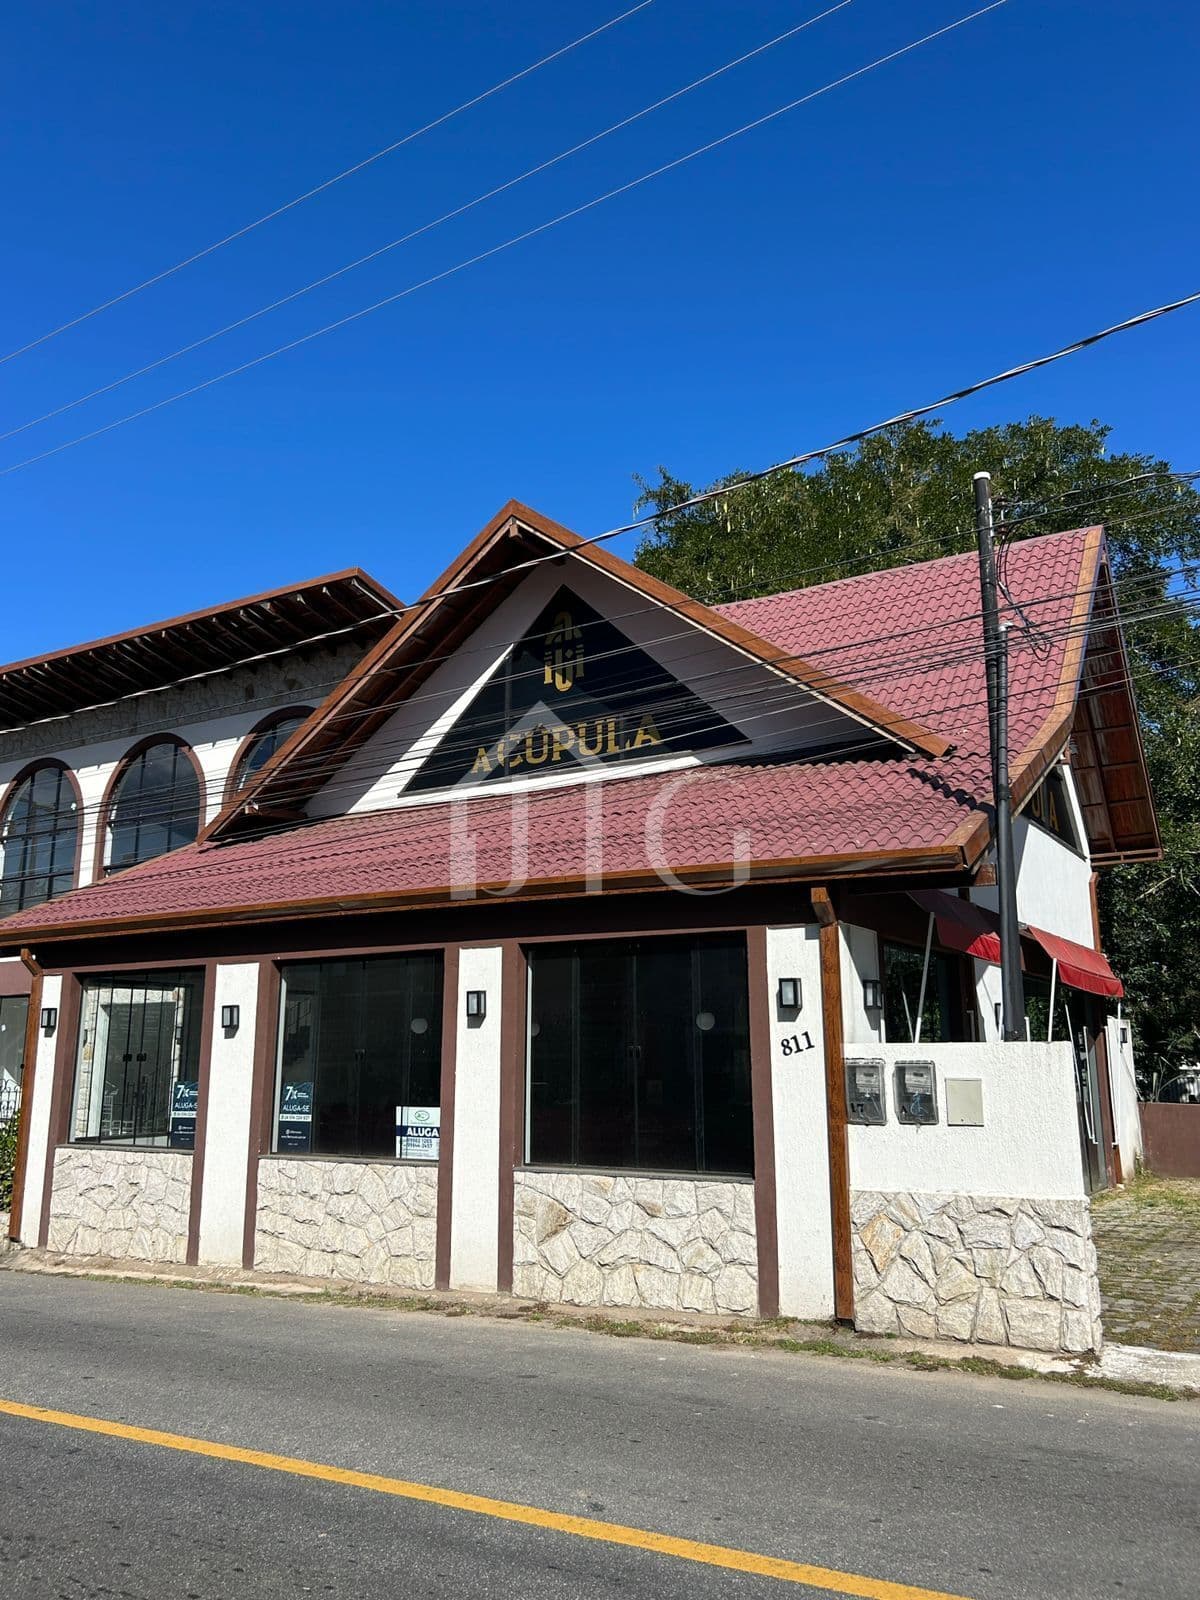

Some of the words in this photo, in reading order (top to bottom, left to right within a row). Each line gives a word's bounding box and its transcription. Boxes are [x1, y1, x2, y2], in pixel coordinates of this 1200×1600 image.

[471, 748, 493, 773] A
[780, 1031, 815, 1057] 811
[407, 1127, 439, 1137] ALUGA
